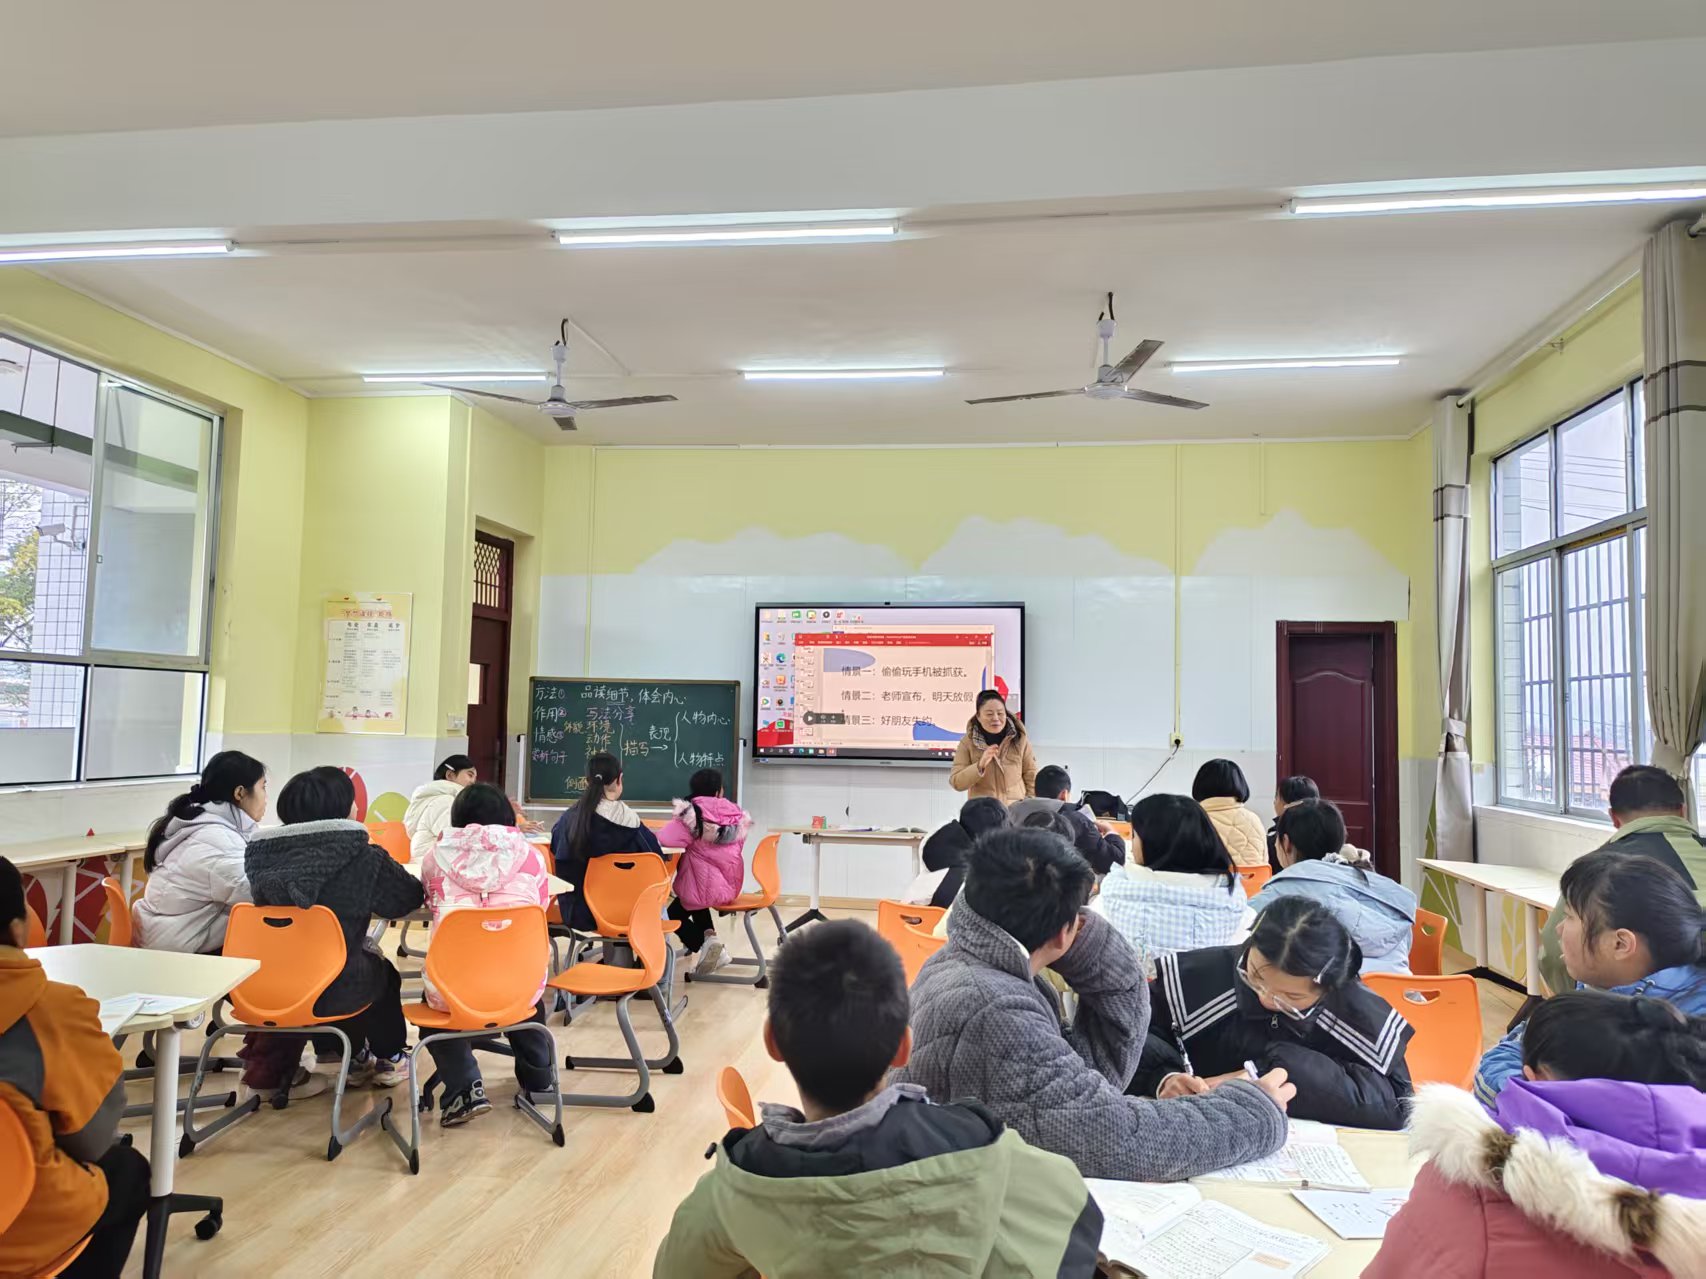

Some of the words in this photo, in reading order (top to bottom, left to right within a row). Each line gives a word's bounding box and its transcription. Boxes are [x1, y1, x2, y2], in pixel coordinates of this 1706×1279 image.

[586, 704, 636, 722] 写法分享
[681, 710, 731, 725] 人物内心
[586, 720, 616, 734] 环境
[648, 725, 671, 741] 表现
[585, 734, 612, 751] 动作
[623, 740, 649, 756] 描写
[678, 751, 725, 768] 人物特点
